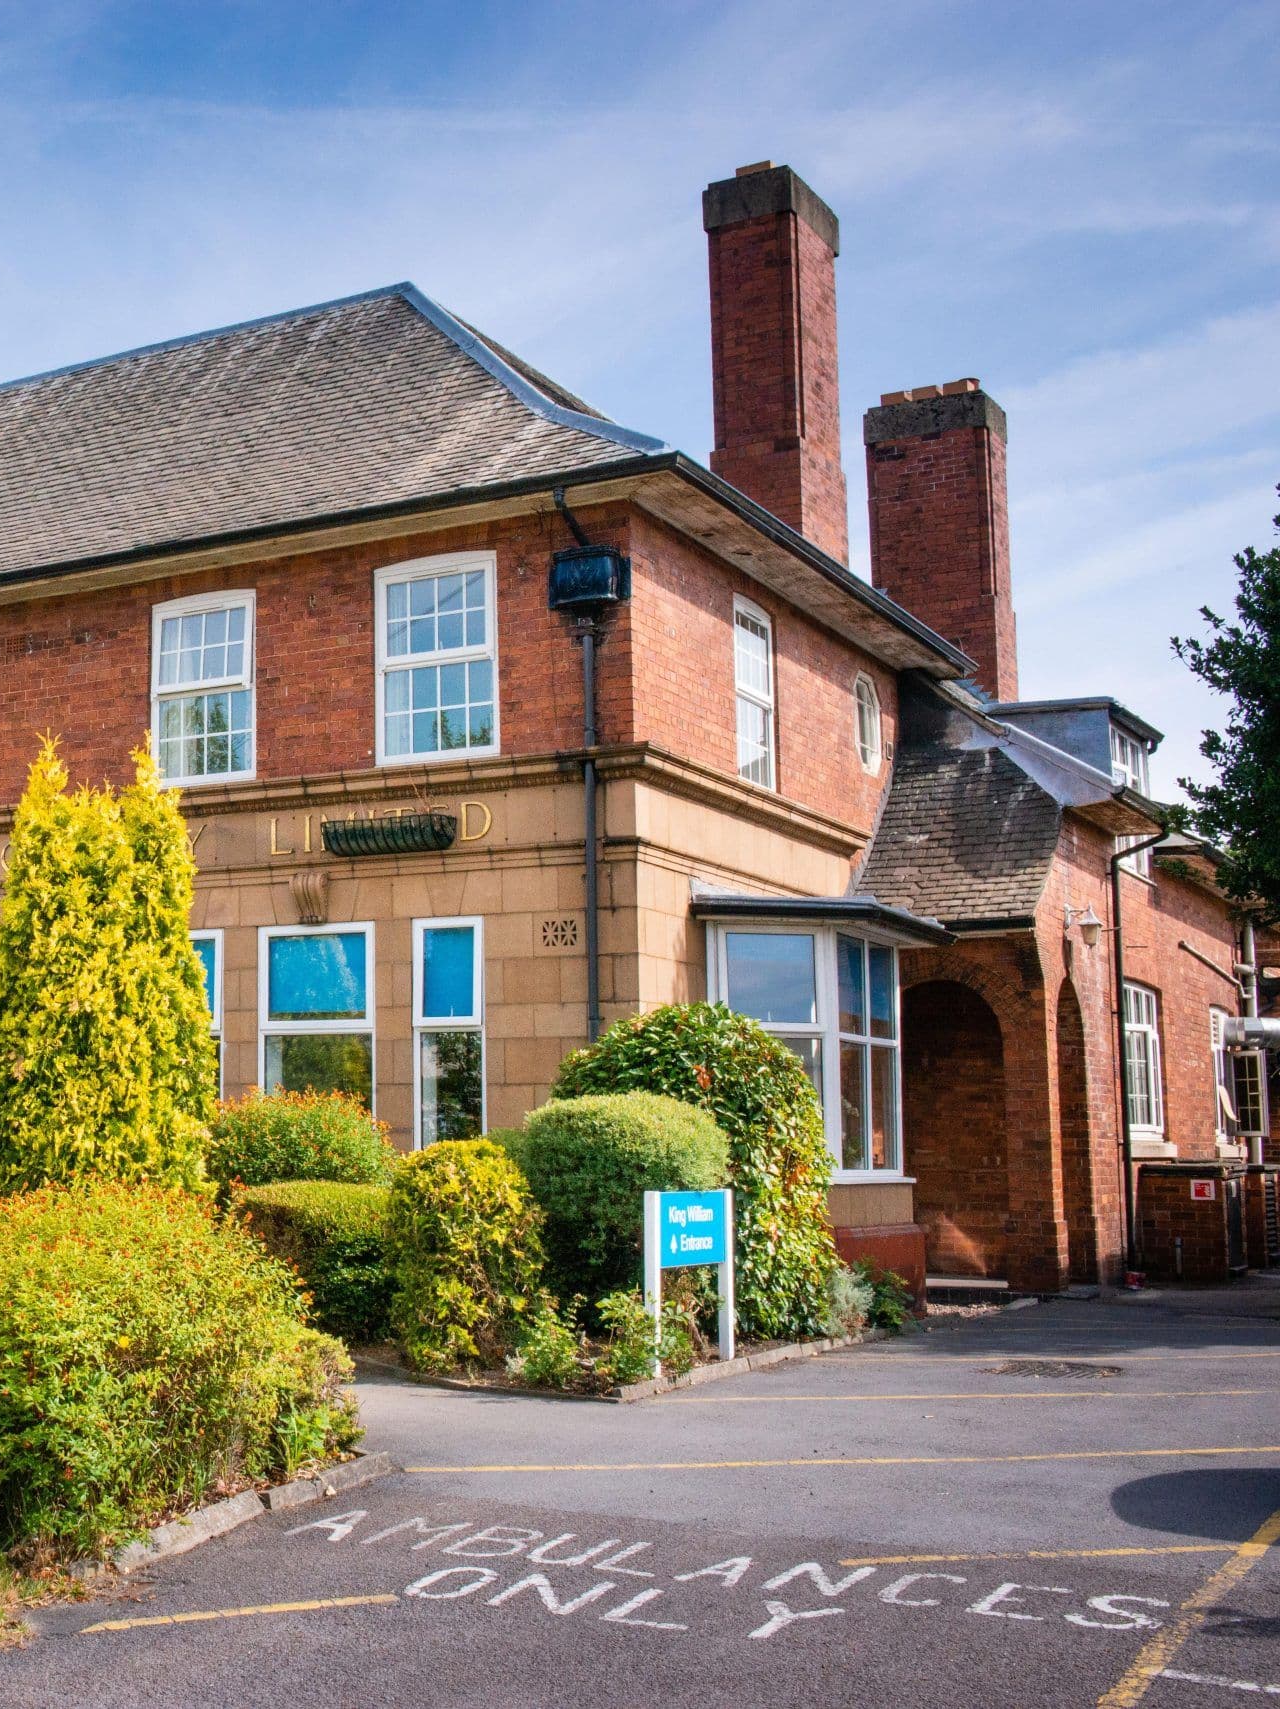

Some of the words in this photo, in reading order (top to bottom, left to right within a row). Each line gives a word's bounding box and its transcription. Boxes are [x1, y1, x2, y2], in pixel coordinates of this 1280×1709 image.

[269, 801, 492, 855] LITD
[668, 1205, 687, 1228] King
[687, 1205, 714, 1222] William
[680, 1233, 713, 1252] Entrance
[283, 1510, 1170, 1630] AMBULANCES
[404, 1566, 845, 1640] ONLY
